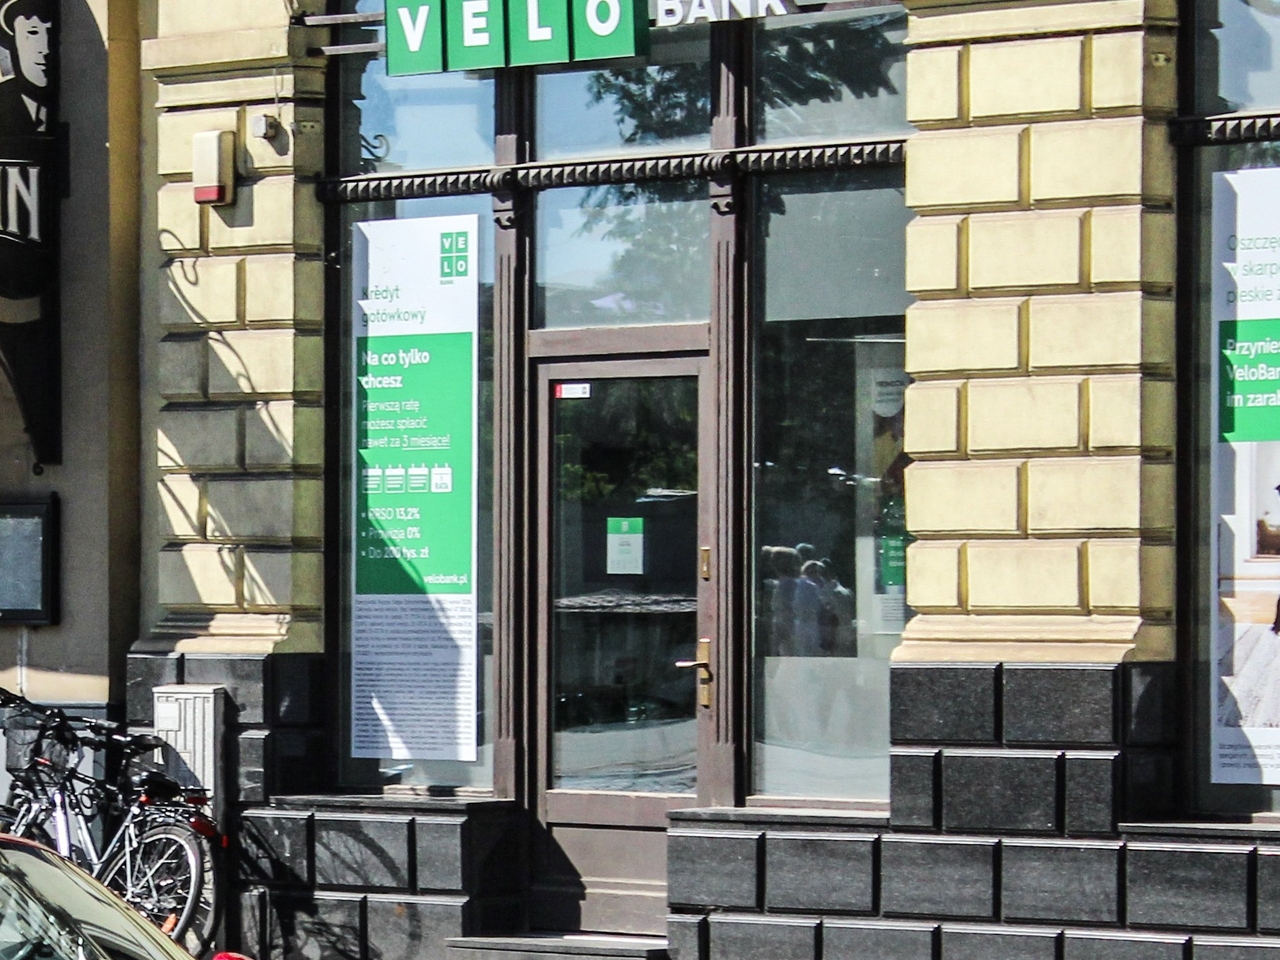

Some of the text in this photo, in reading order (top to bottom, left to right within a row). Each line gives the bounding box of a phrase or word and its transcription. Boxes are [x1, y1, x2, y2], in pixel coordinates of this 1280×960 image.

[397, 0, 621, 52] VELO
[1227, 234, 1280, 253] Oszczę
[1242, 260, 1280, 279] skarp
[361, 285, 400, 303] Kredyt
[361, 308, 426, 327] gotówkowy
[1227, 337, 1280, 359] Przynie
[362, 348, 430, 369] Na co tylko
[361, 373, 403, 389] chcesz
[1227, 391, 1243, 408] im
[362, 436, 388, 448] nawet
[390, 438, 400, 447] za
[402, 435, 409, 447] 3
[369, 527, 420, 542] Prowizja 0%
[369, 547, 382, 558] Do
[423, 573, 468, 585] velobank.pl
